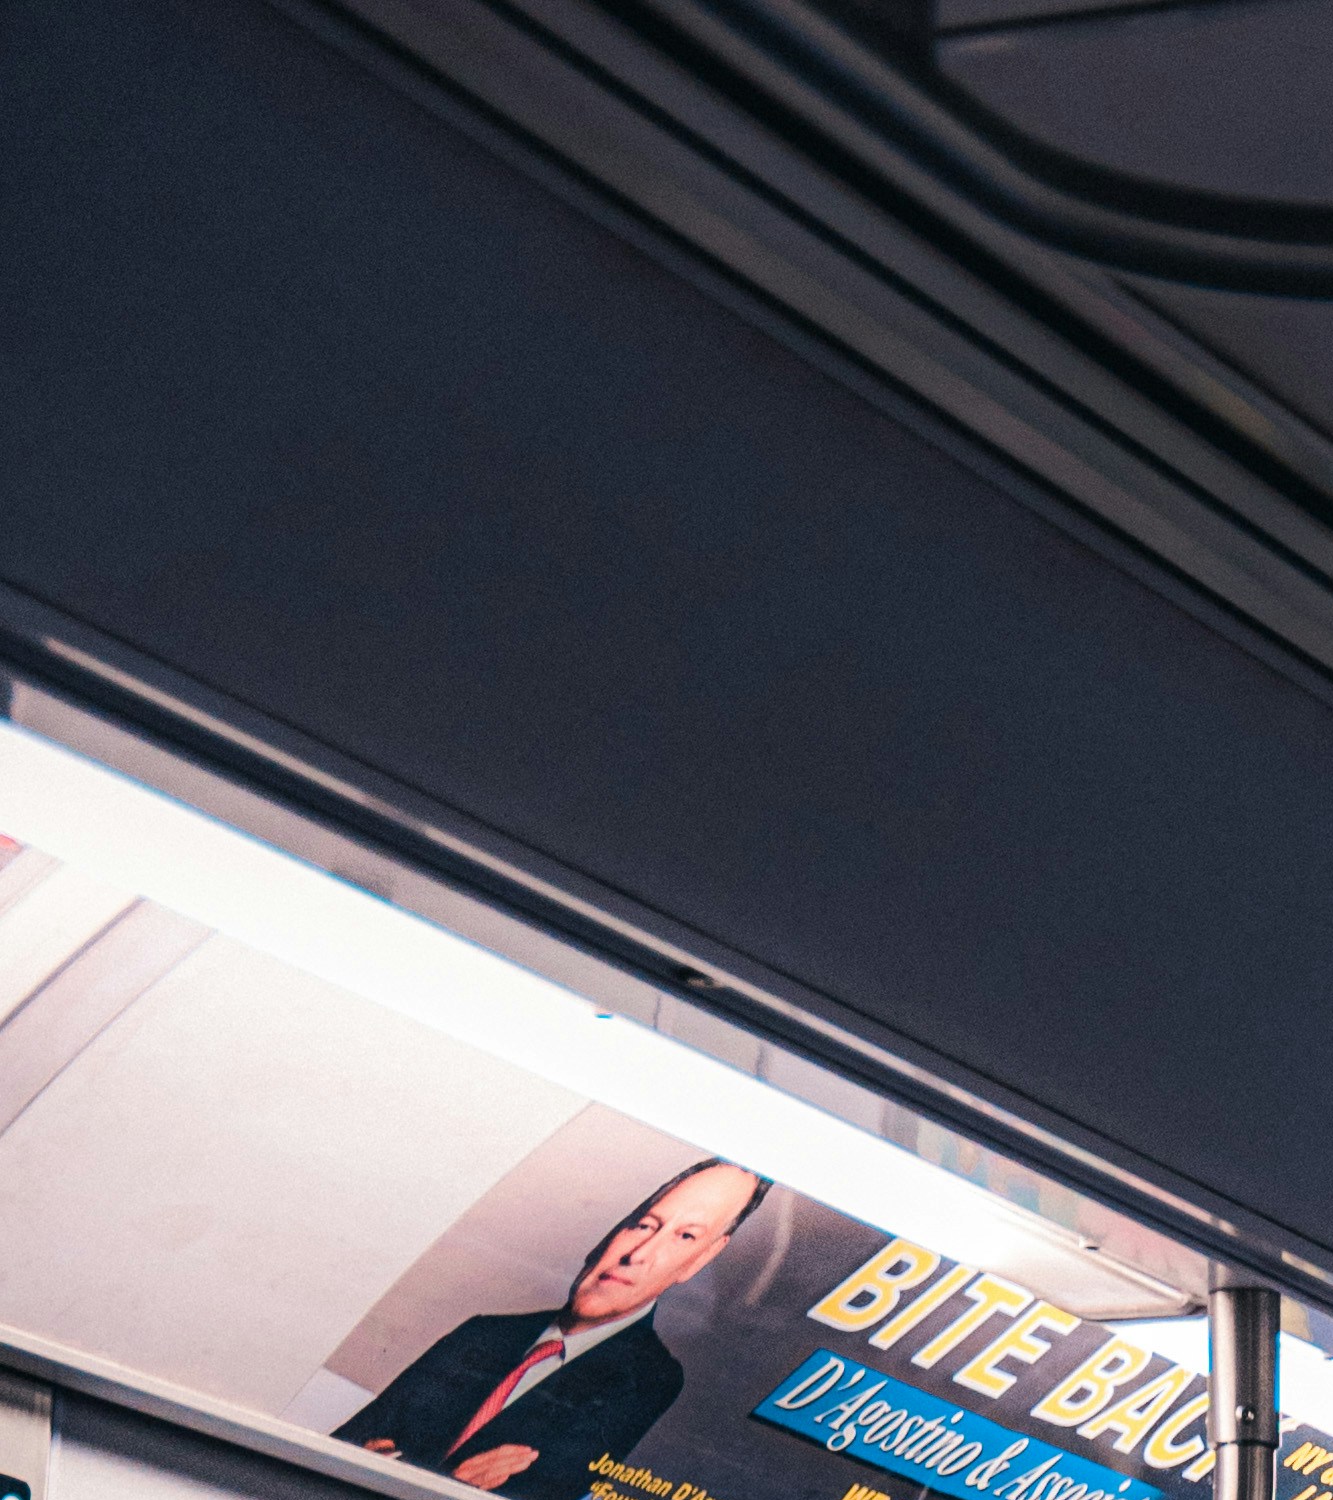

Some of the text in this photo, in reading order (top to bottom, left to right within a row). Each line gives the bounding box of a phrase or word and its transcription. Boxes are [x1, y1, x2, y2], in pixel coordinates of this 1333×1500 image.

[773, 1355, 984, 1477] D'Agostino
[976, 1437, 1029, 1491] &
[807, 1236, 1299, 1484] BITE BAC
[588, 1451, 673, 1498] Jonathan
